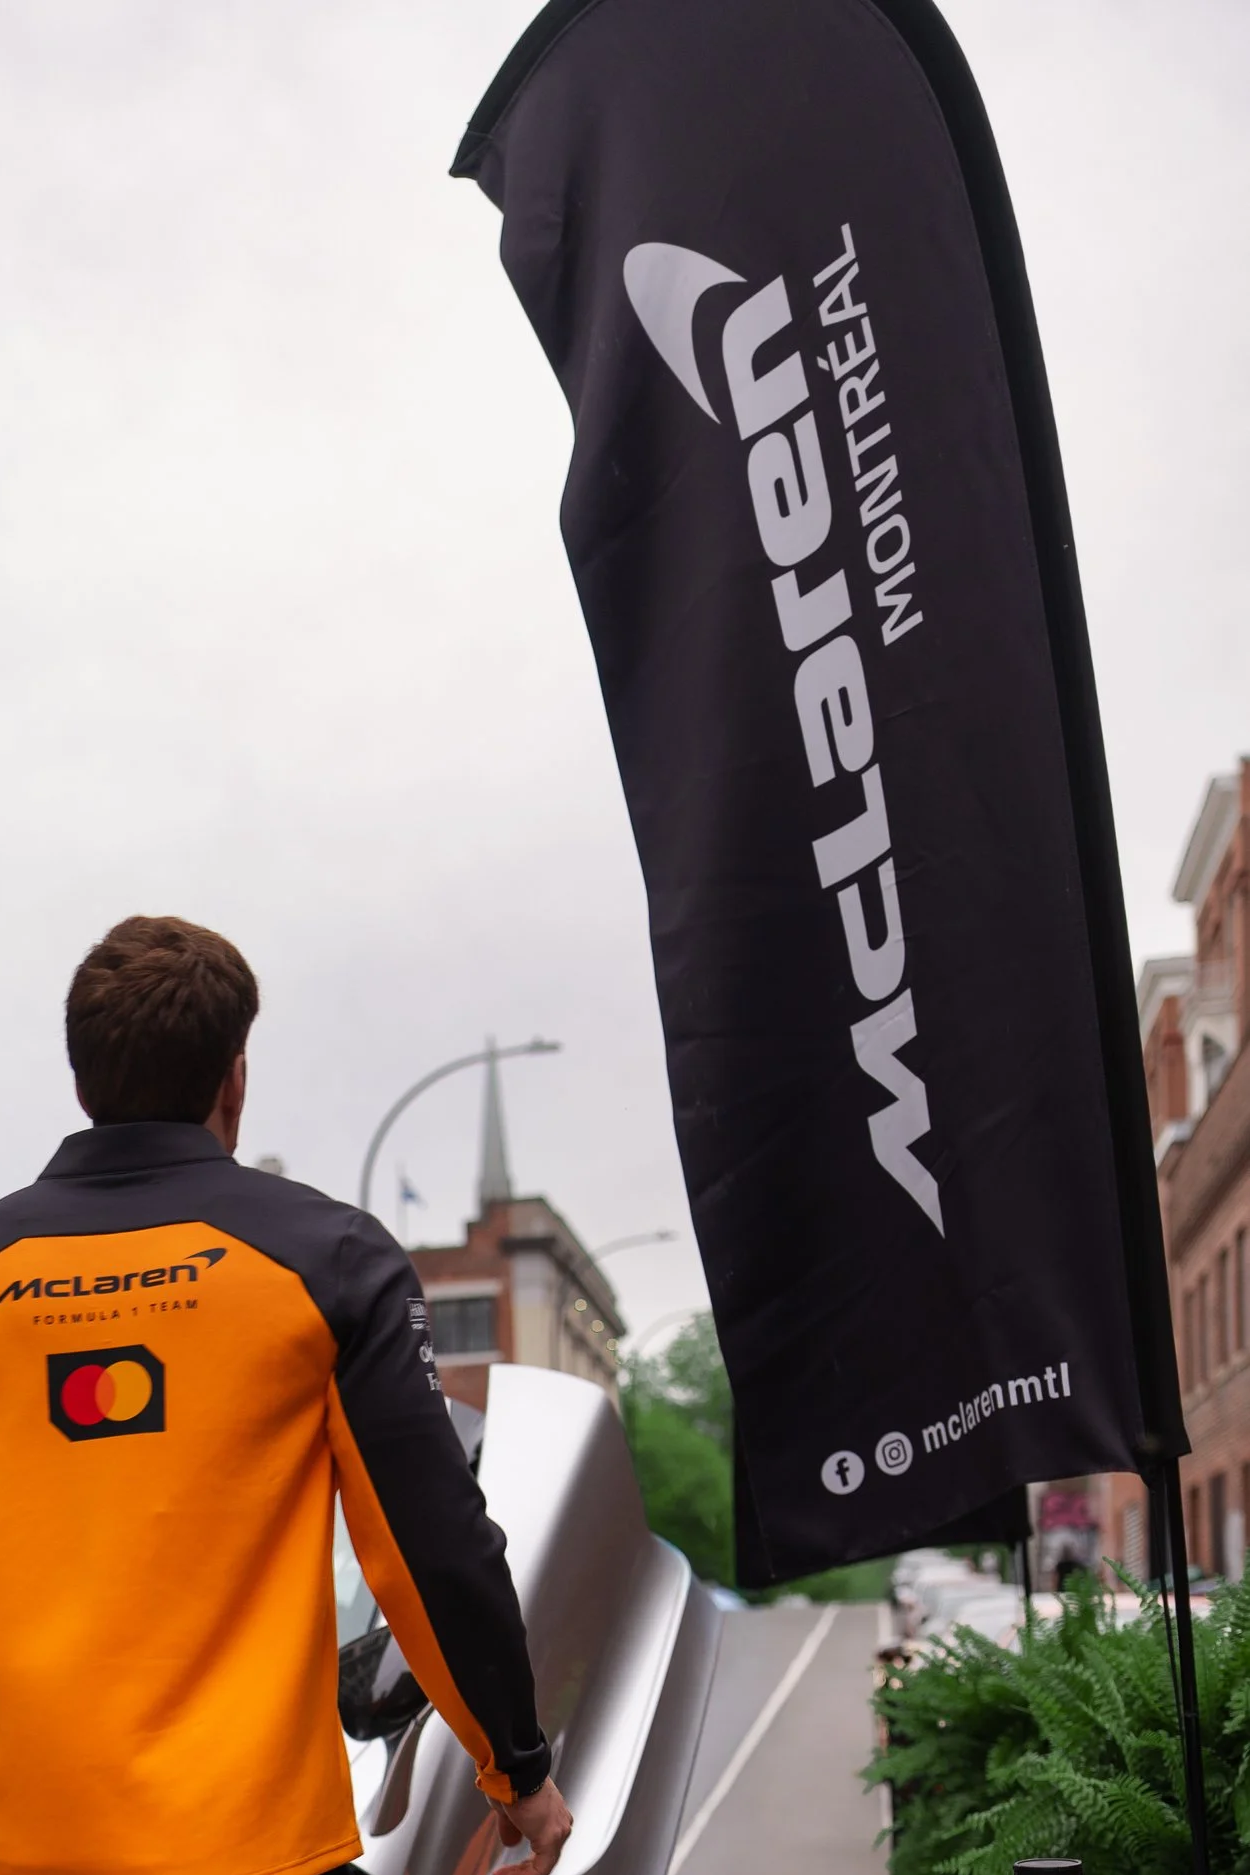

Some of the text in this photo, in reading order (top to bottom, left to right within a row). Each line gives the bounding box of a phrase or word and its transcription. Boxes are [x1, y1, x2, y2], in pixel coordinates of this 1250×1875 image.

[813, 222, 924, 646] MONTRÉAL
[721, 274, 946, 1239] McLaren
[32, 1299, 199, 1326] FORMULA 1 TEAM
[922, 1362, 1072, 1454] mclarenmtl
